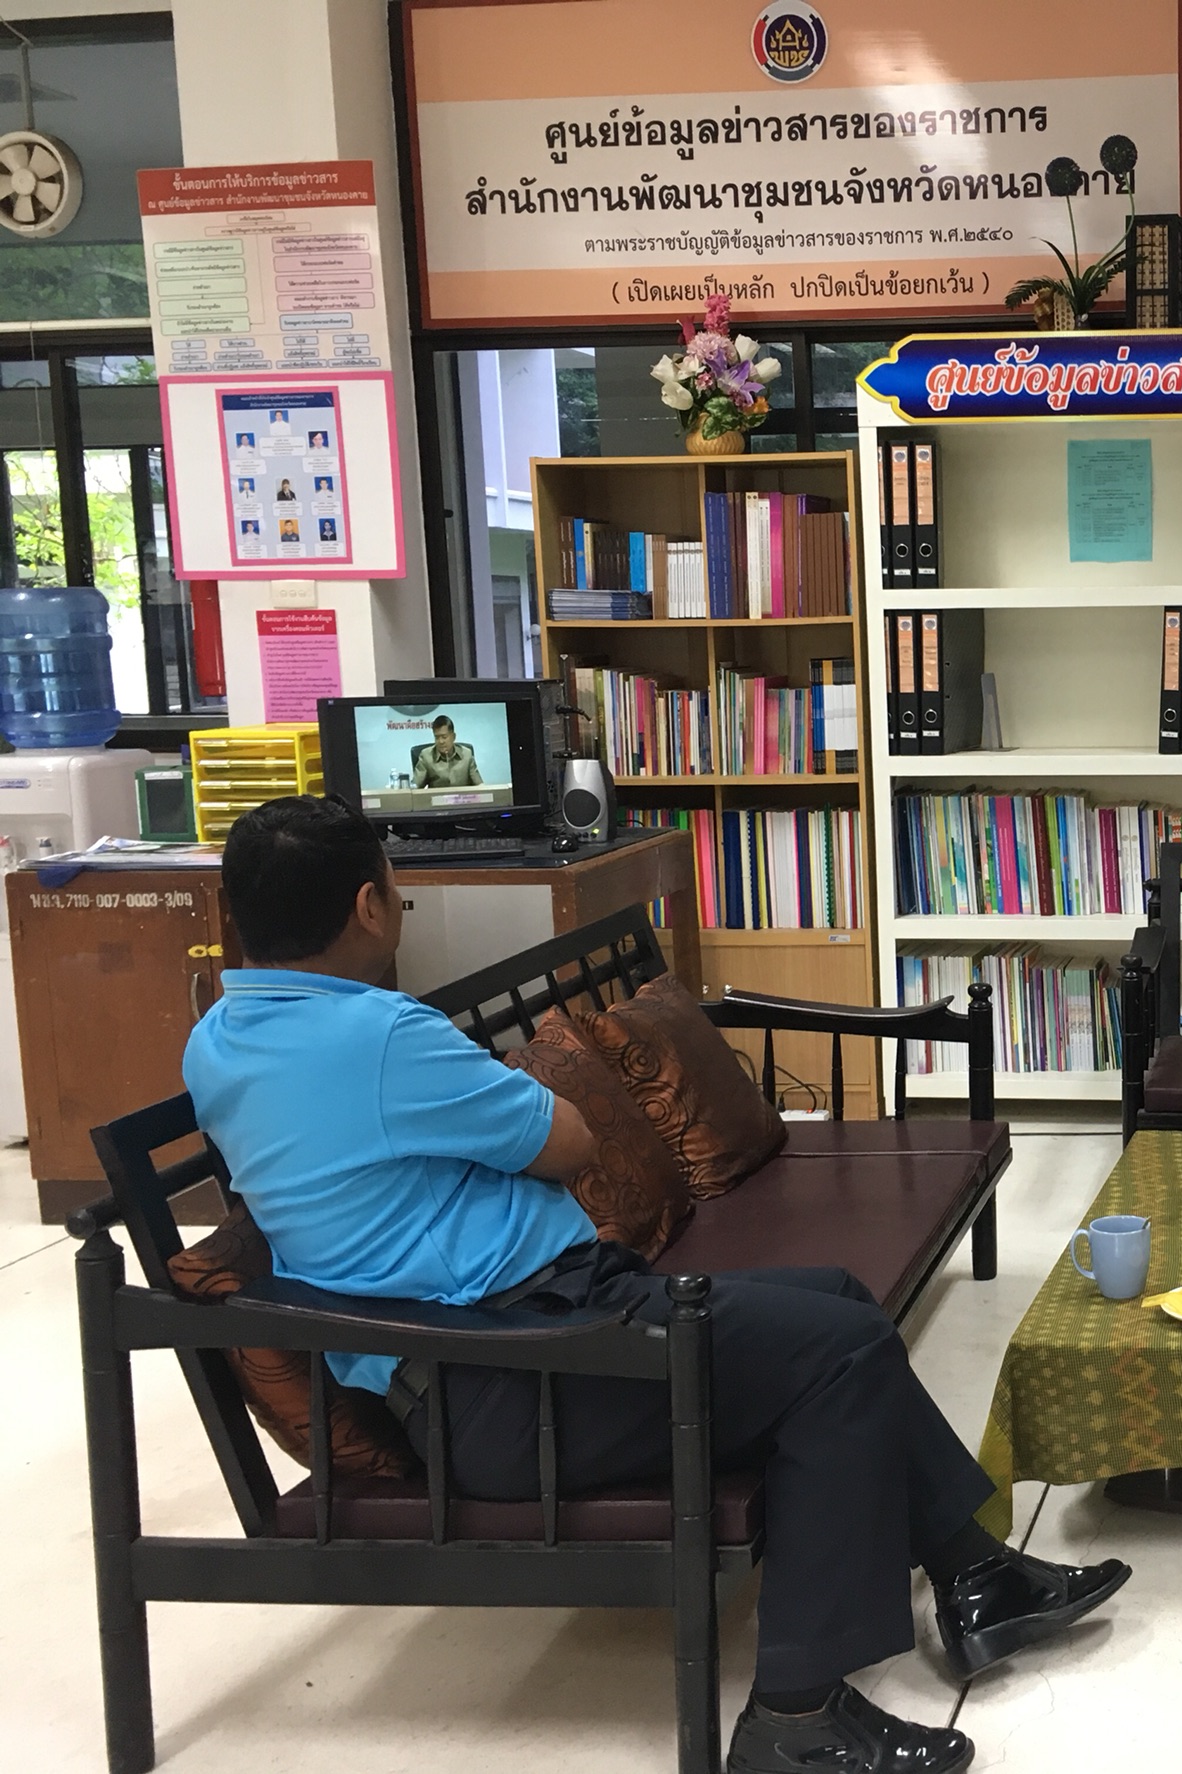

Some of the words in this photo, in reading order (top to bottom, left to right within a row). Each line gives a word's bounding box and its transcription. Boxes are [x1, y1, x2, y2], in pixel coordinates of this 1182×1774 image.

[544, 104, 1049, 164] ศูนย์ข้อมูลข่าวสารของราชการ
[464, 164, 1136, 224] สำนักงานพัฒนาชุมชนจังหวัดหนอาย
[584, 228, 923, 256] ตามพระราชบัญญัติข้อมูลข่าวสารของราชการ
[929, 225, 1014, 244] พ.ศ.๒๕๔๐
[627, 273, 775, 302] เปิดเผยเป็นหลัก
[790, 268, 974, 299] ปกปิดเป็นข้อยกเว้น
